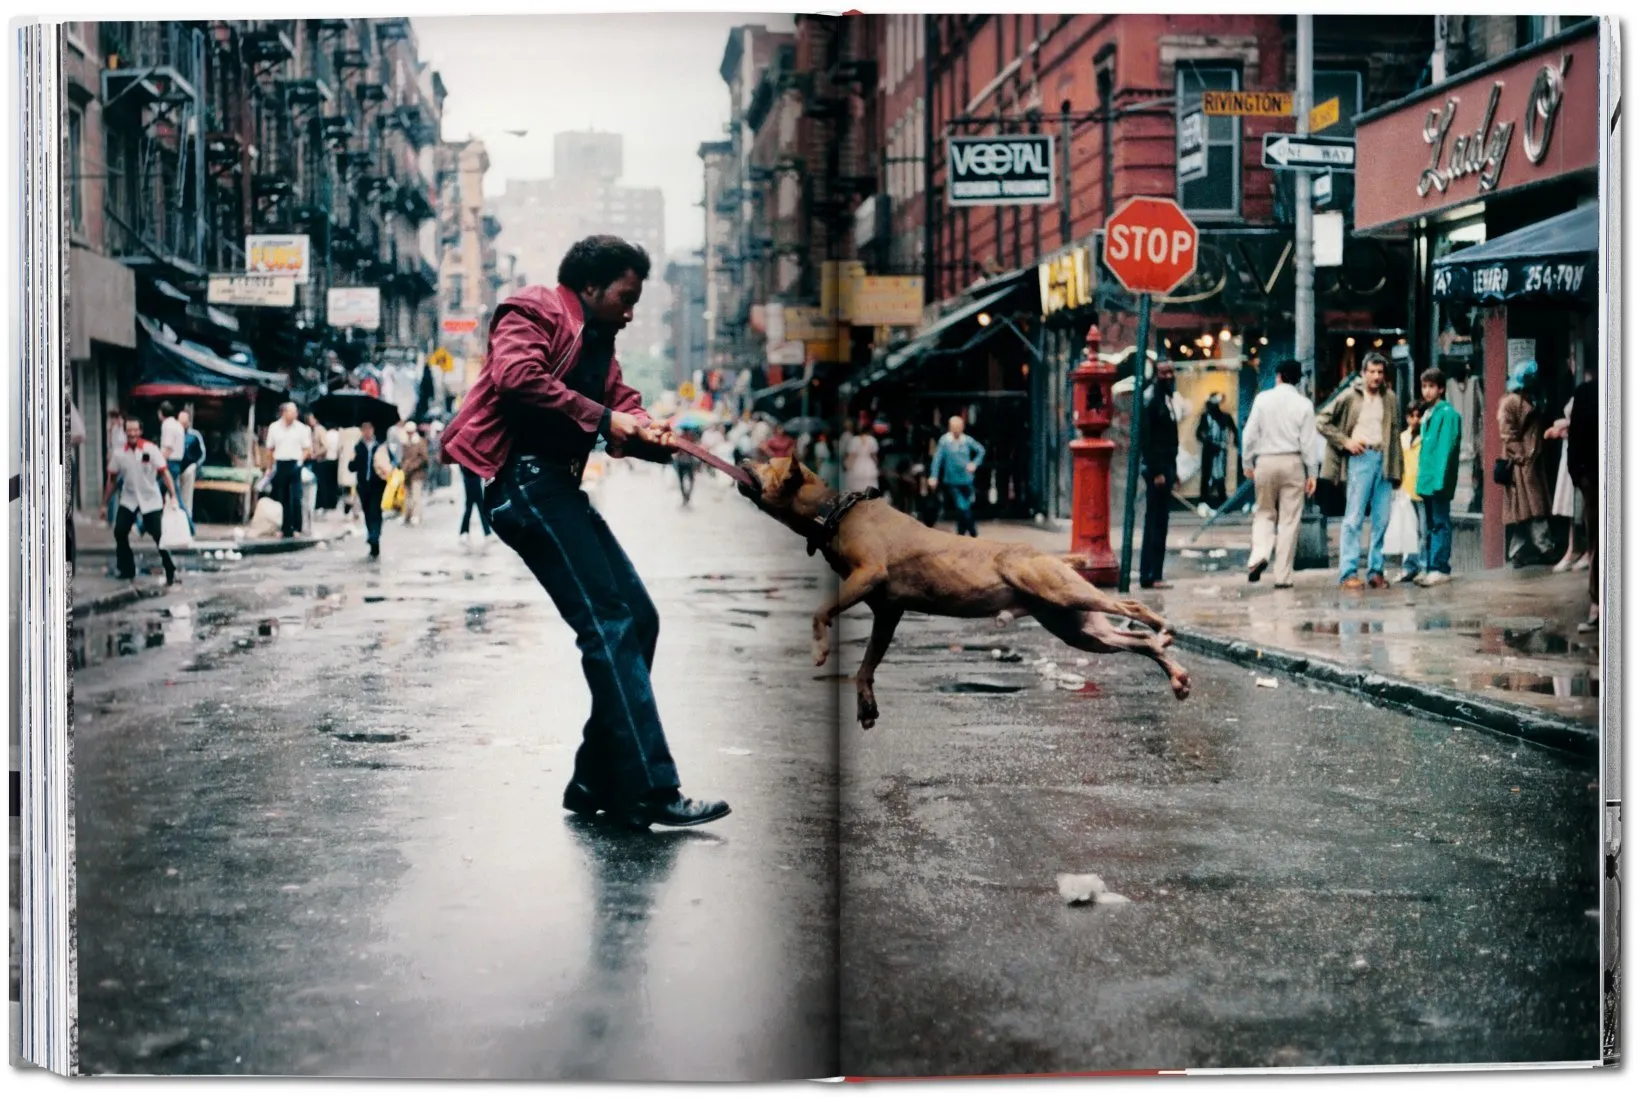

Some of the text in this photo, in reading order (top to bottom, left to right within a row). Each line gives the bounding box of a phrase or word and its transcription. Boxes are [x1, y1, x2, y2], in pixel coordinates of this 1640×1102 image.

[1204, 93, 1282, 112] RIVINGTON
[1321, 148, 1348, 160] WAY
[1417, 81, 1514, 197] Lady
[1109, 223, 1192, 265] STOP
